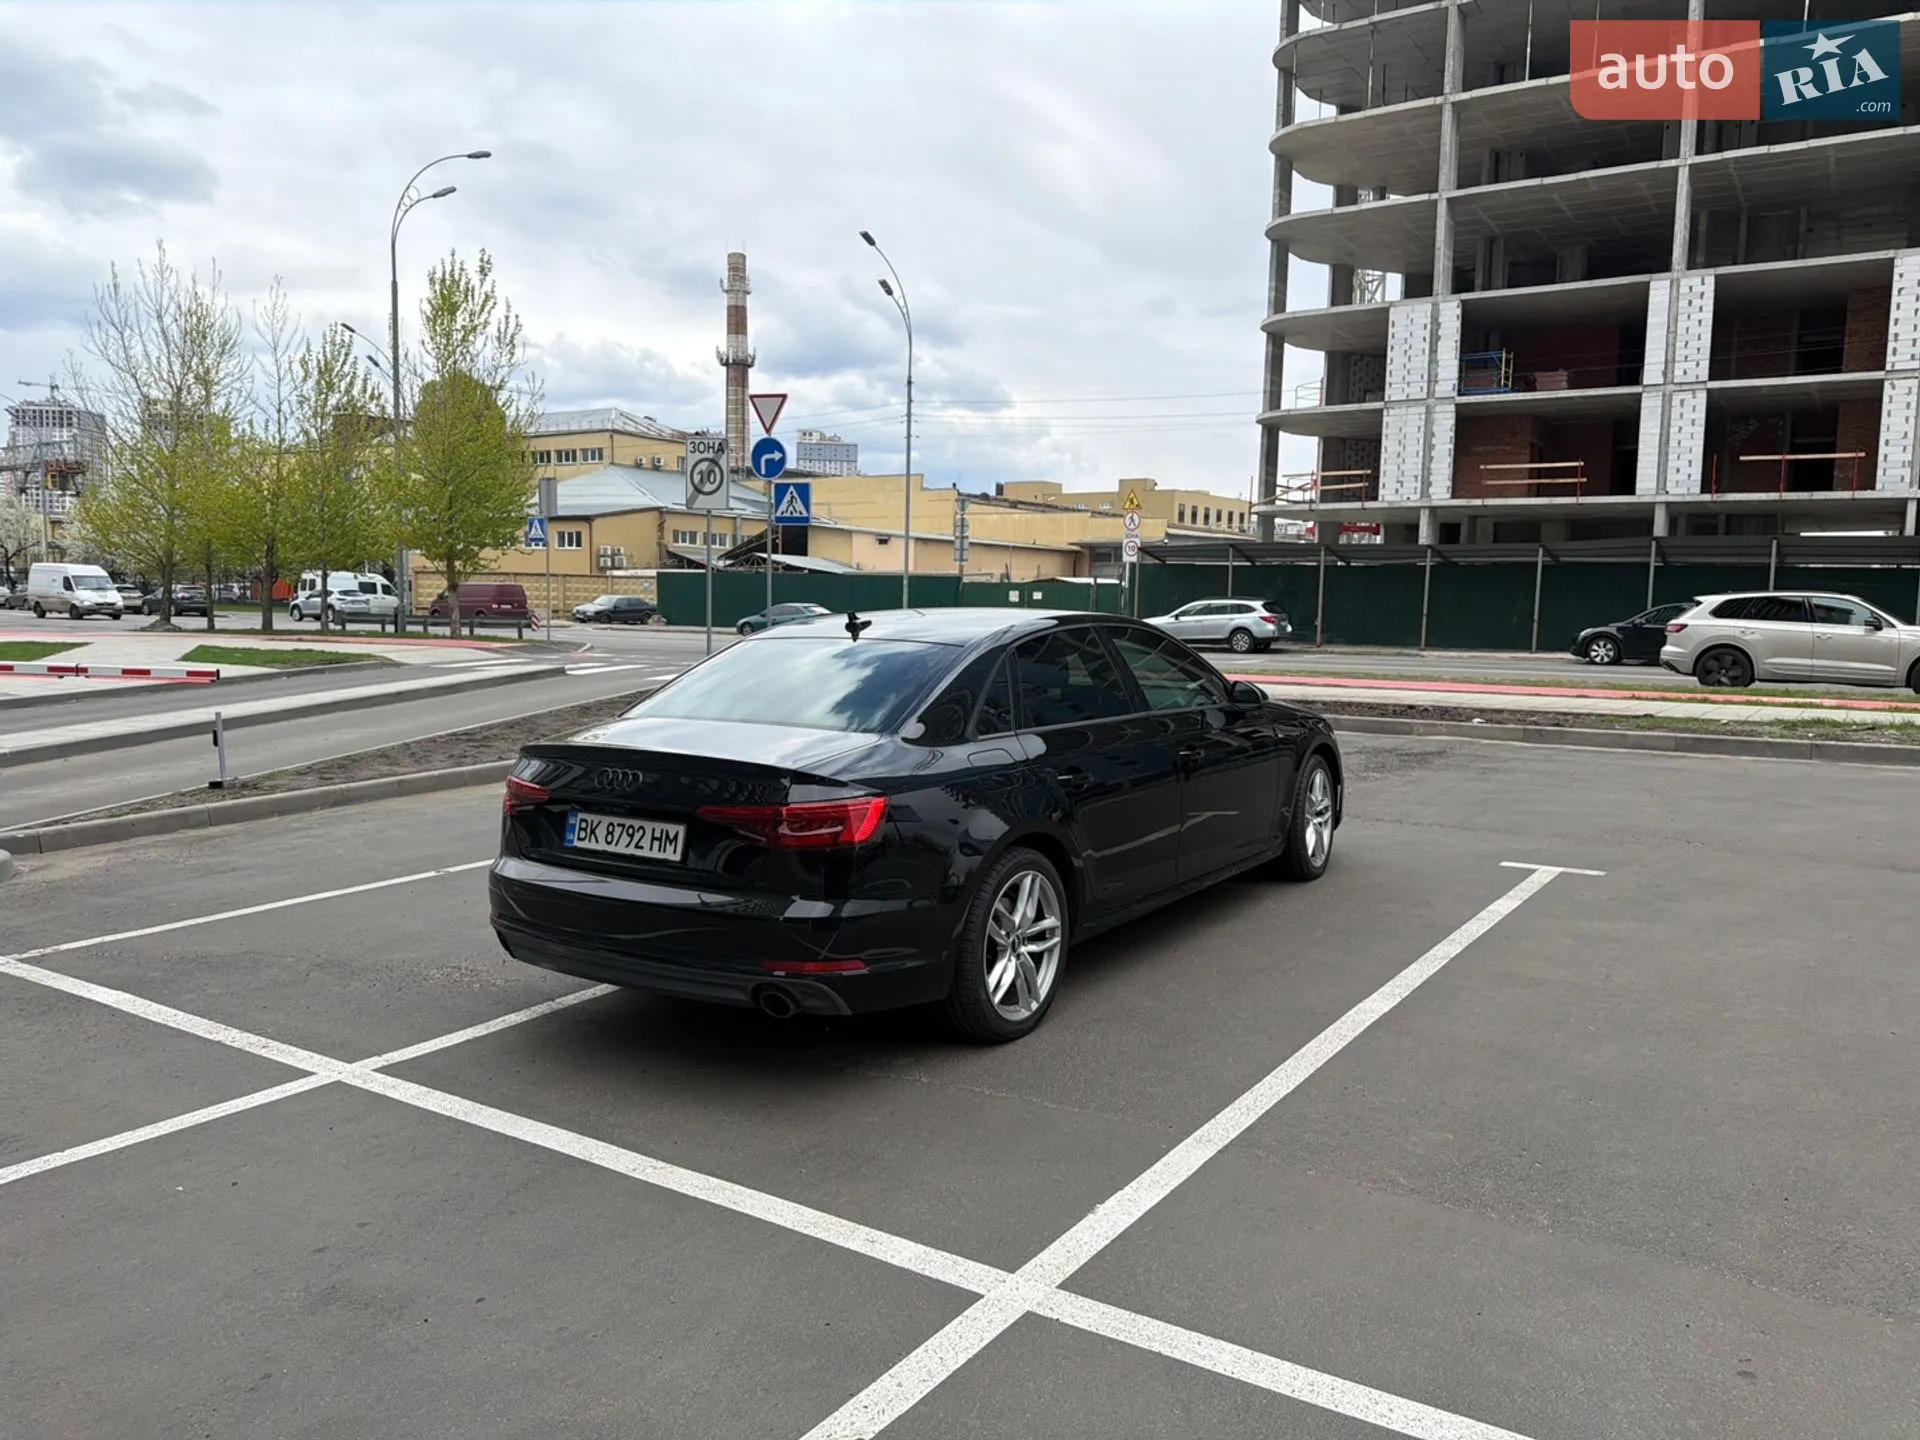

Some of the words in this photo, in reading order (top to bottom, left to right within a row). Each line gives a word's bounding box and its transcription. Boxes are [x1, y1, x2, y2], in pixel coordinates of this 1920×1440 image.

[689, 441, 725, 454] ЗОНА
[697, 469, 717, 485] 10
[604, 822, 647, 850] 8792
